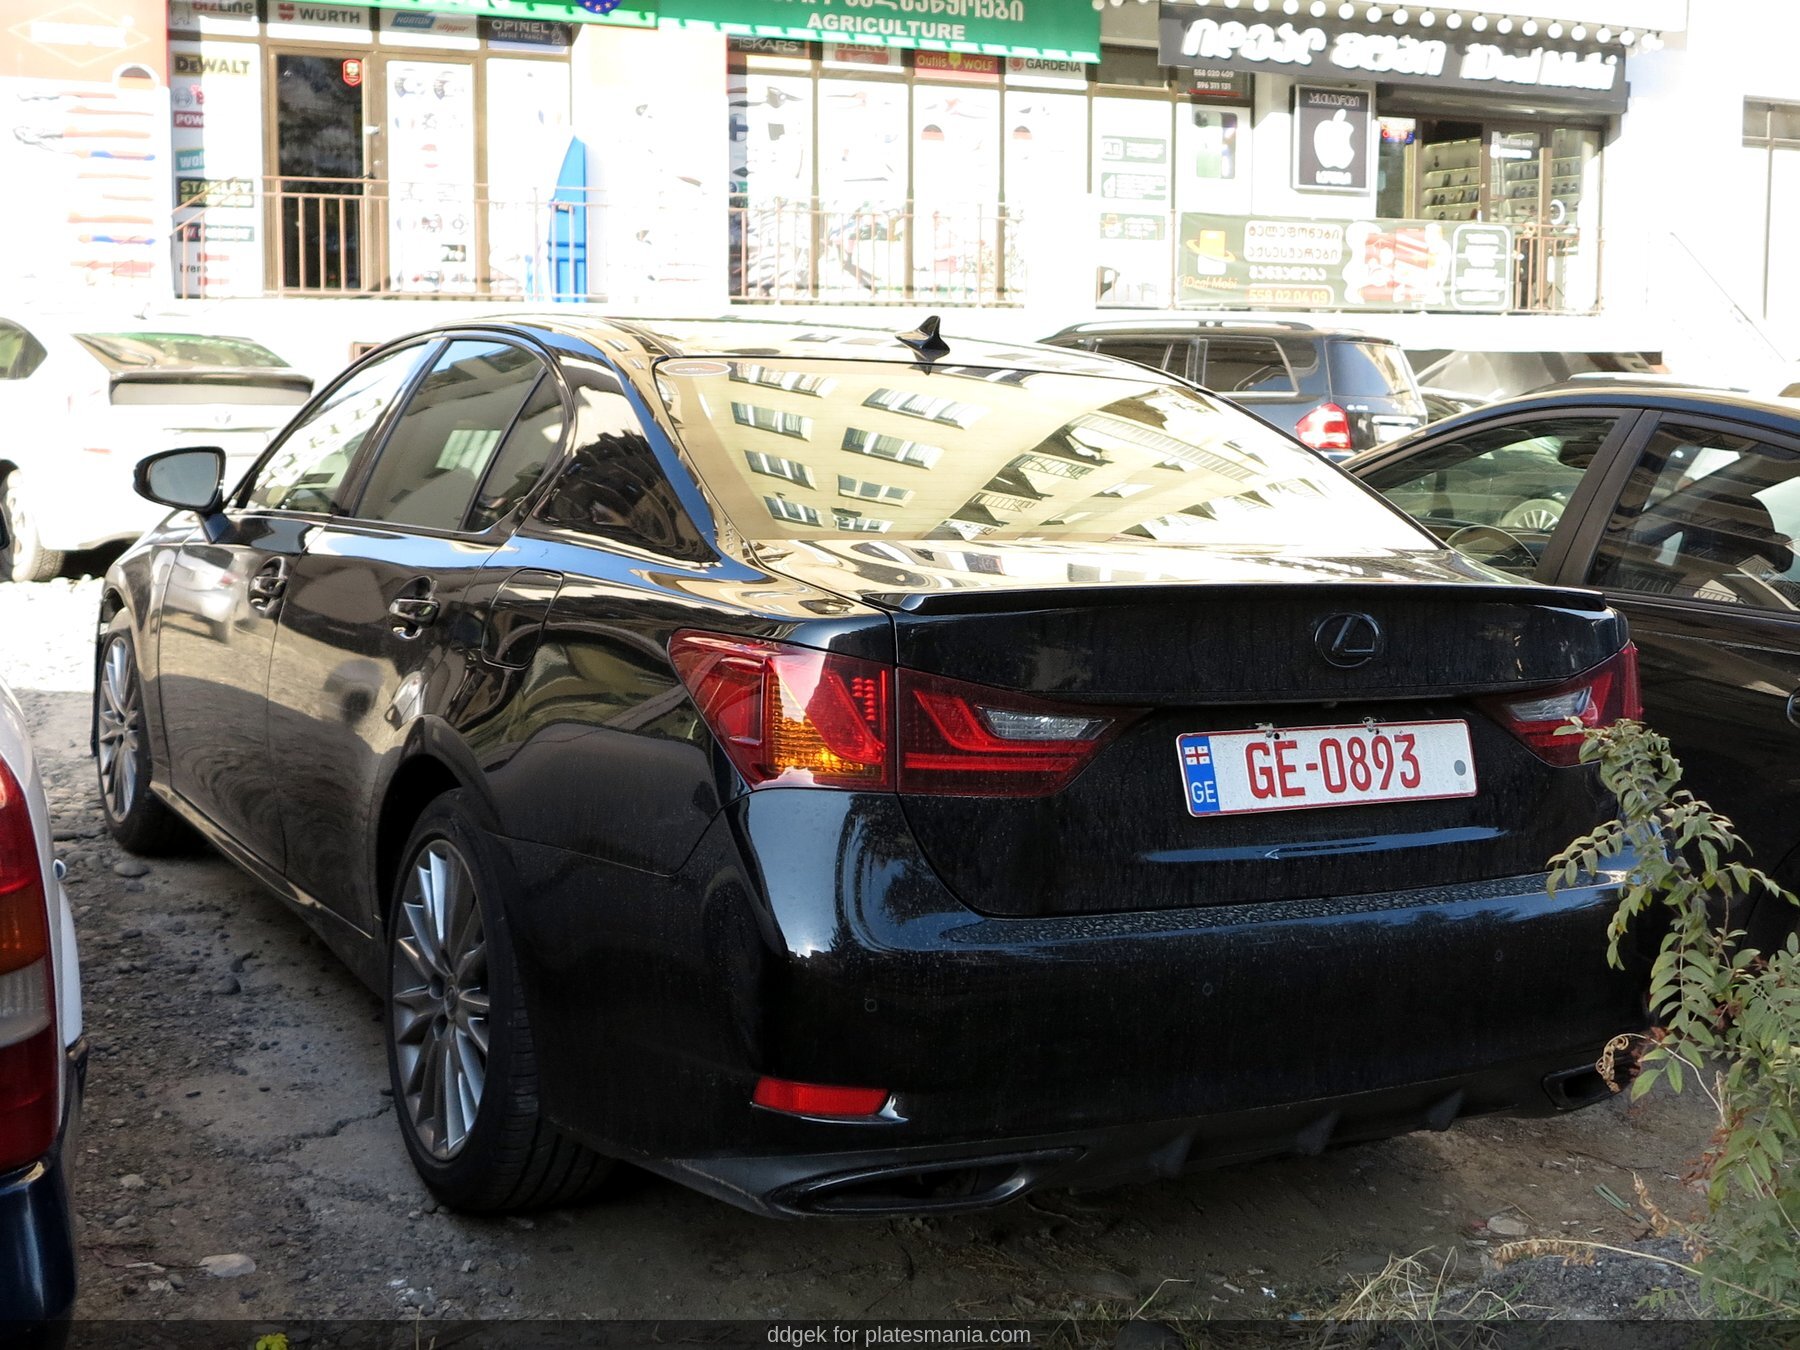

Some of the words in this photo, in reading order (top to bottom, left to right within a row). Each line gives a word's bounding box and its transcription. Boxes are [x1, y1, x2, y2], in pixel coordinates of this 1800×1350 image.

[299, 7, 360, 24] WÜRTH
[491, 20, 550, 34] OPINEL
[807, 12, 966, 41] AGRICULTURE
[916, 54, 947, 69] Outils
[963, 59, 994, 72] WOLF
[1025, 58, 1081, 73] GARDENA
[1207, 70, 1220, 78] 020
[1196, 81, 1209, 89] 596
[1275, 290, 1291, 303] 02
[1311, 291, 1328, 305] 09
[1245, 733, 1422, 800] GE-0893
[1190, 780, 1217, 804] GE
